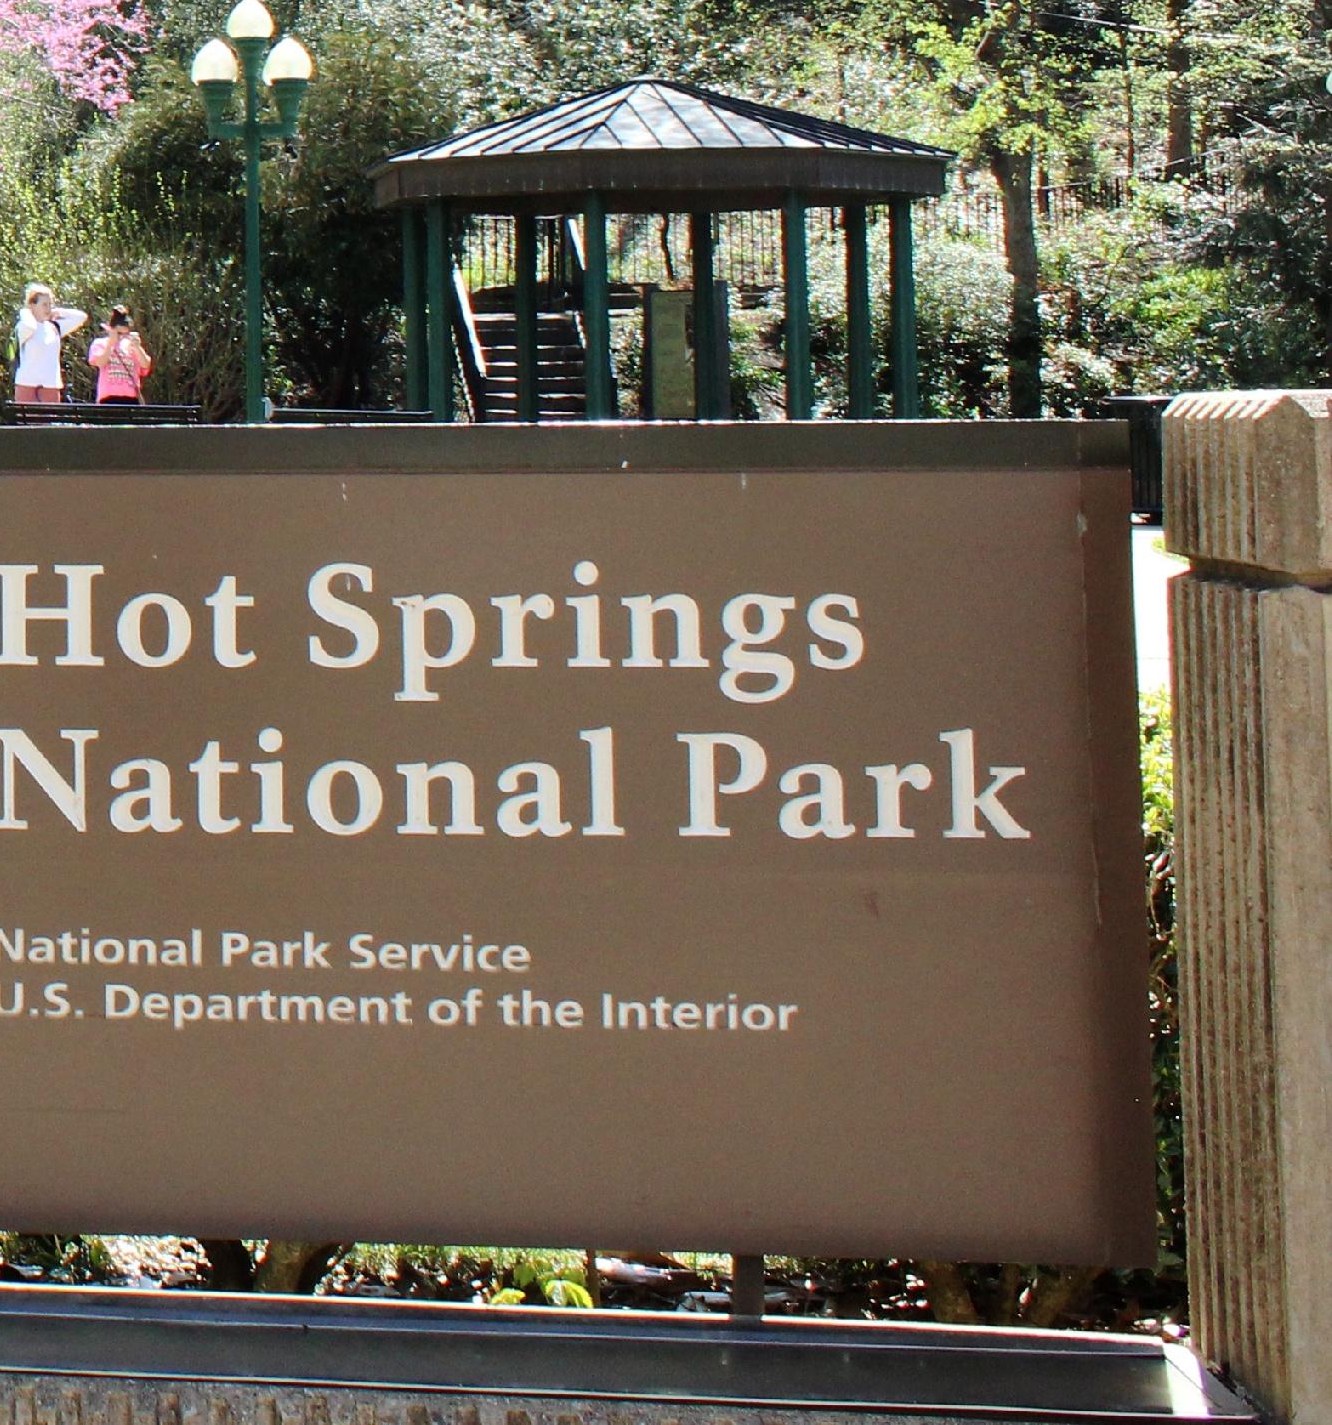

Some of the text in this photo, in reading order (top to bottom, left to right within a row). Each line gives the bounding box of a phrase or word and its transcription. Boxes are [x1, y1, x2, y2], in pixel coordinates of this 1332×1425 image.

[308, 560, 864, 704] Springs
[676, 728, 1031, 839] Park
[221, 931, 330, 968] Park
[349, 933, 530, 971] Service
[105, 984, 412, 1028] Department
[428, 988, 482, 1025] of
[497, 989, 584, 1028] the
[602, 993, 797, 1030] Interior
